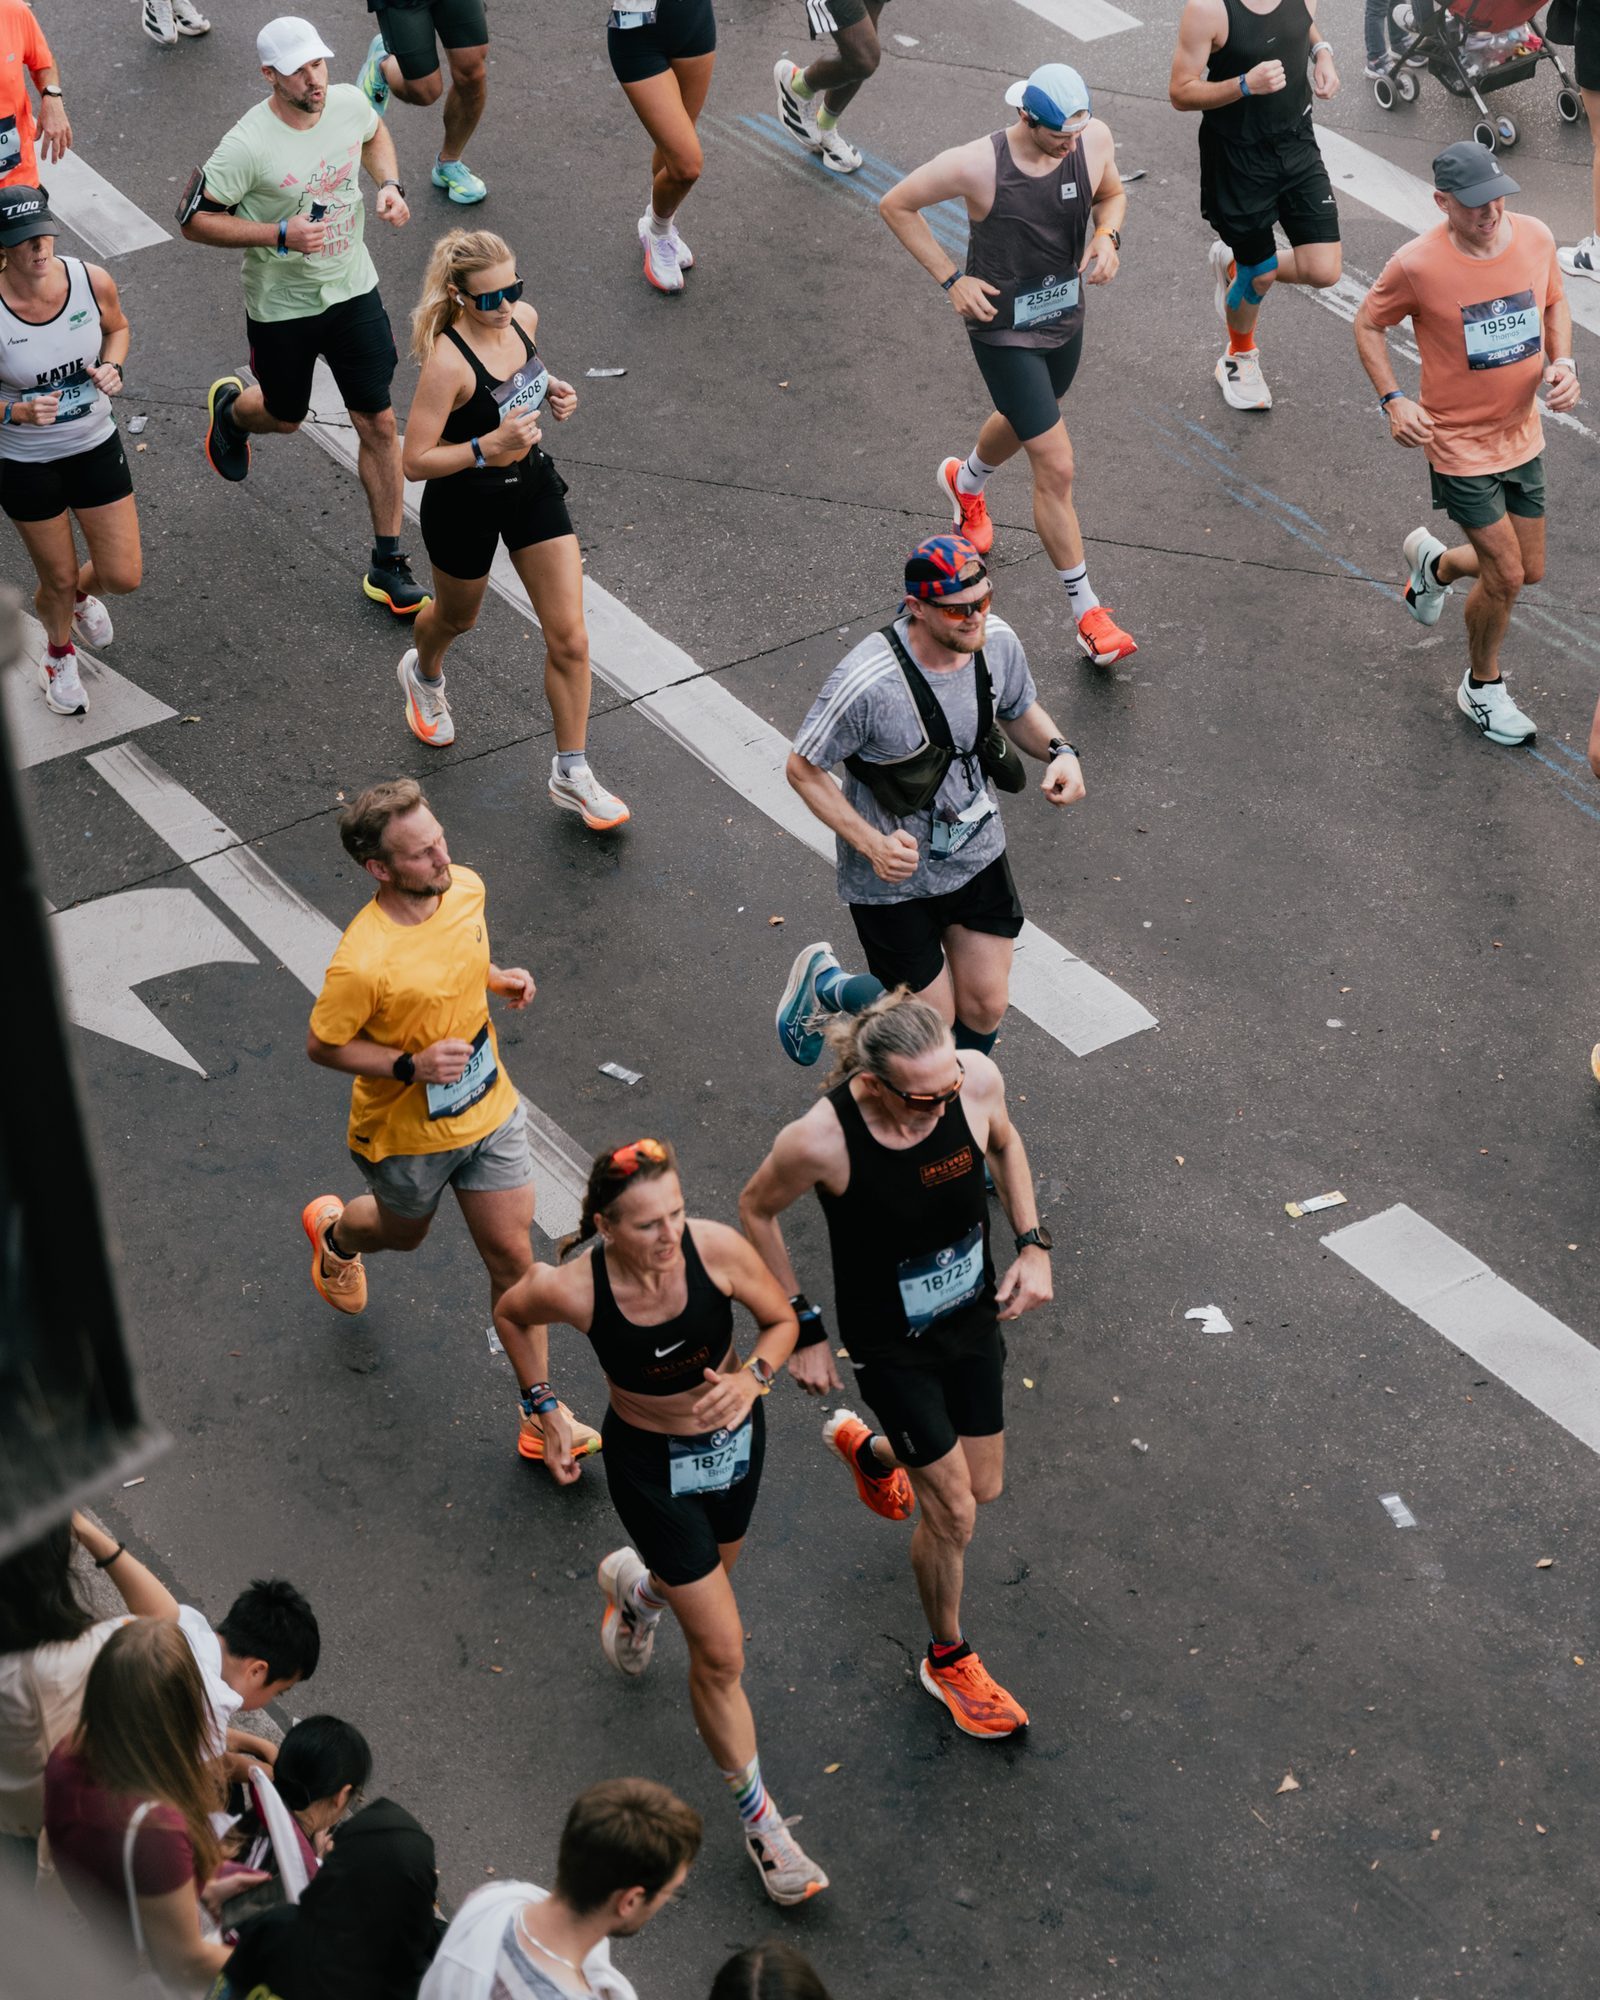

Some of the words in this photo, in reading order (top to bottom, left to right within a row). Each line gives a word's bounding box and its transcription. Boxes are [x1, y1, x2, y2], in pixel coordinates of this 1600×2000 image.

[2, 201, 40, 216] T100
[1027, 284, 1068, 306] 25346
[1480, 312, 1527, 335] 19594
[1489, 330, 1520, 341] Thomas
[1488, 344, 1526, 361] zalando
[921, 1257, 972, 1294] 18723
